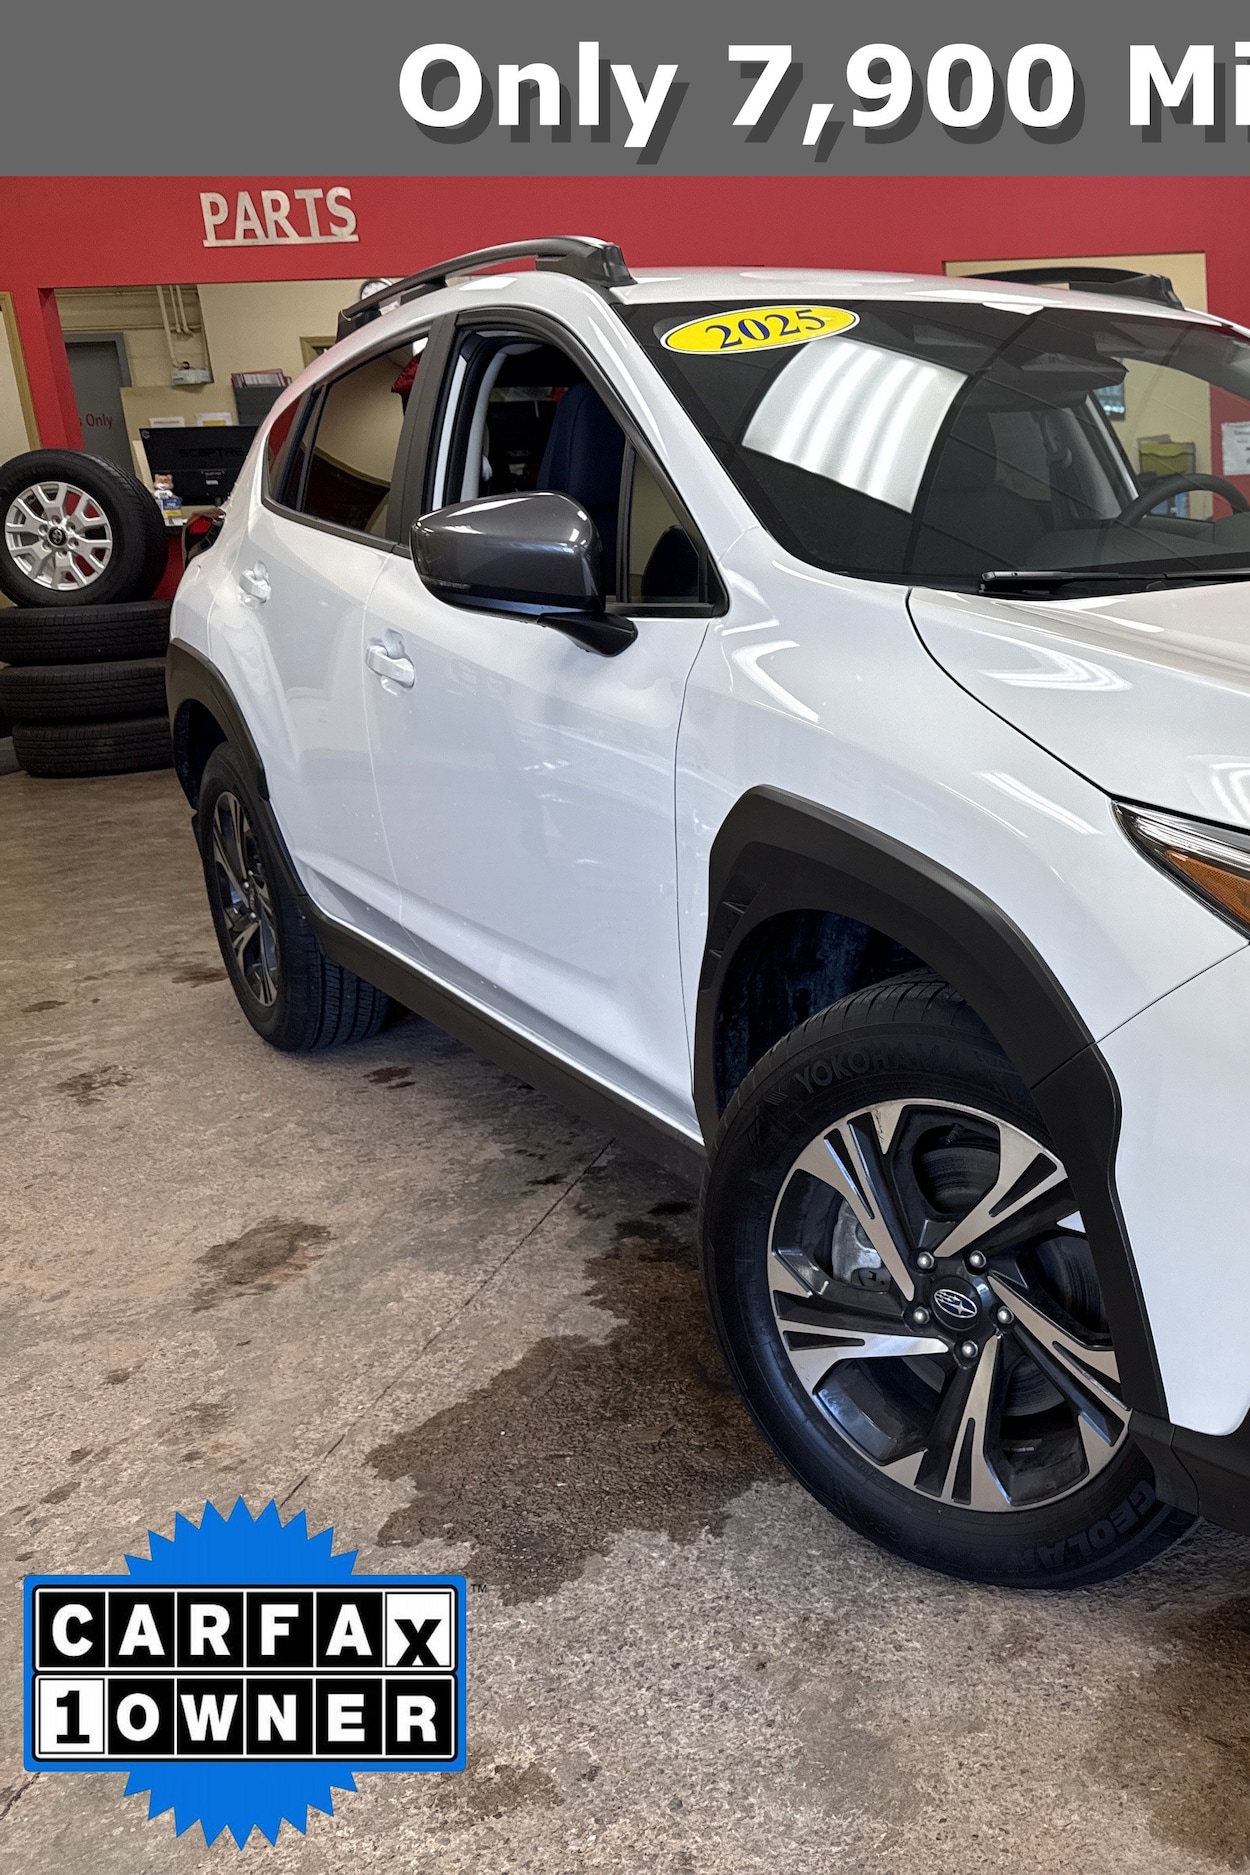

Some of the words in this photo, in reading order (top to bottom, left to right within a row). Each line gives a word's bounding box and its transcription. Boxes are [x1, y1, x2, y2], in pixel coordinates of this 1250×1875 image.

[200, 186, 358, 244] PARTS
[705, 309, 825, 349] 2025
[86, 413, 113, 430] Only
[179, 447, 243, 458] SCEPTRE
[795, 1042, 961, 1094] YOKOHAMA
